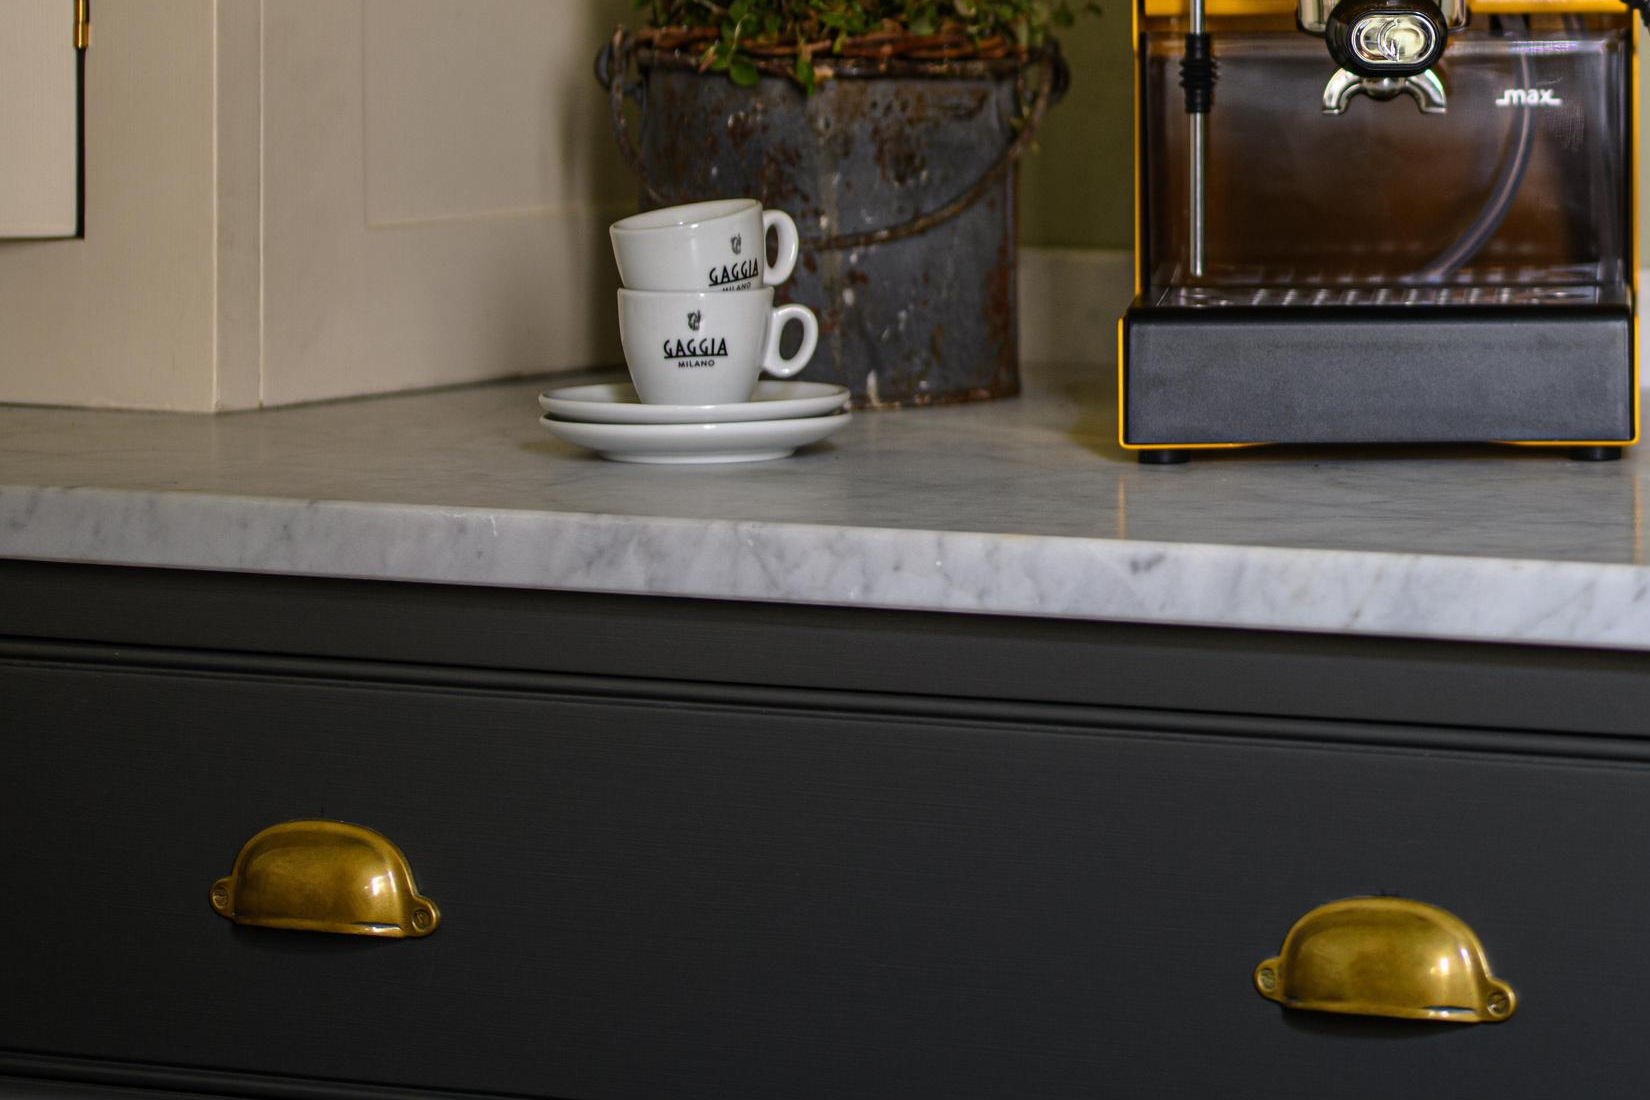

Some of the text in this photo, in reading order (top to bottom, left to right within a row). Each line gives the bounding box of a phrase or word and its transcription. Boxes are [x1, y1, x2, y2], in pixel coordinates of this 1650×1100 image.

[709, 258, 759, 287] GAGGIA
[663, 338, 728, 359] GAGGIA
[678, 360, 715, 368] MILANO
